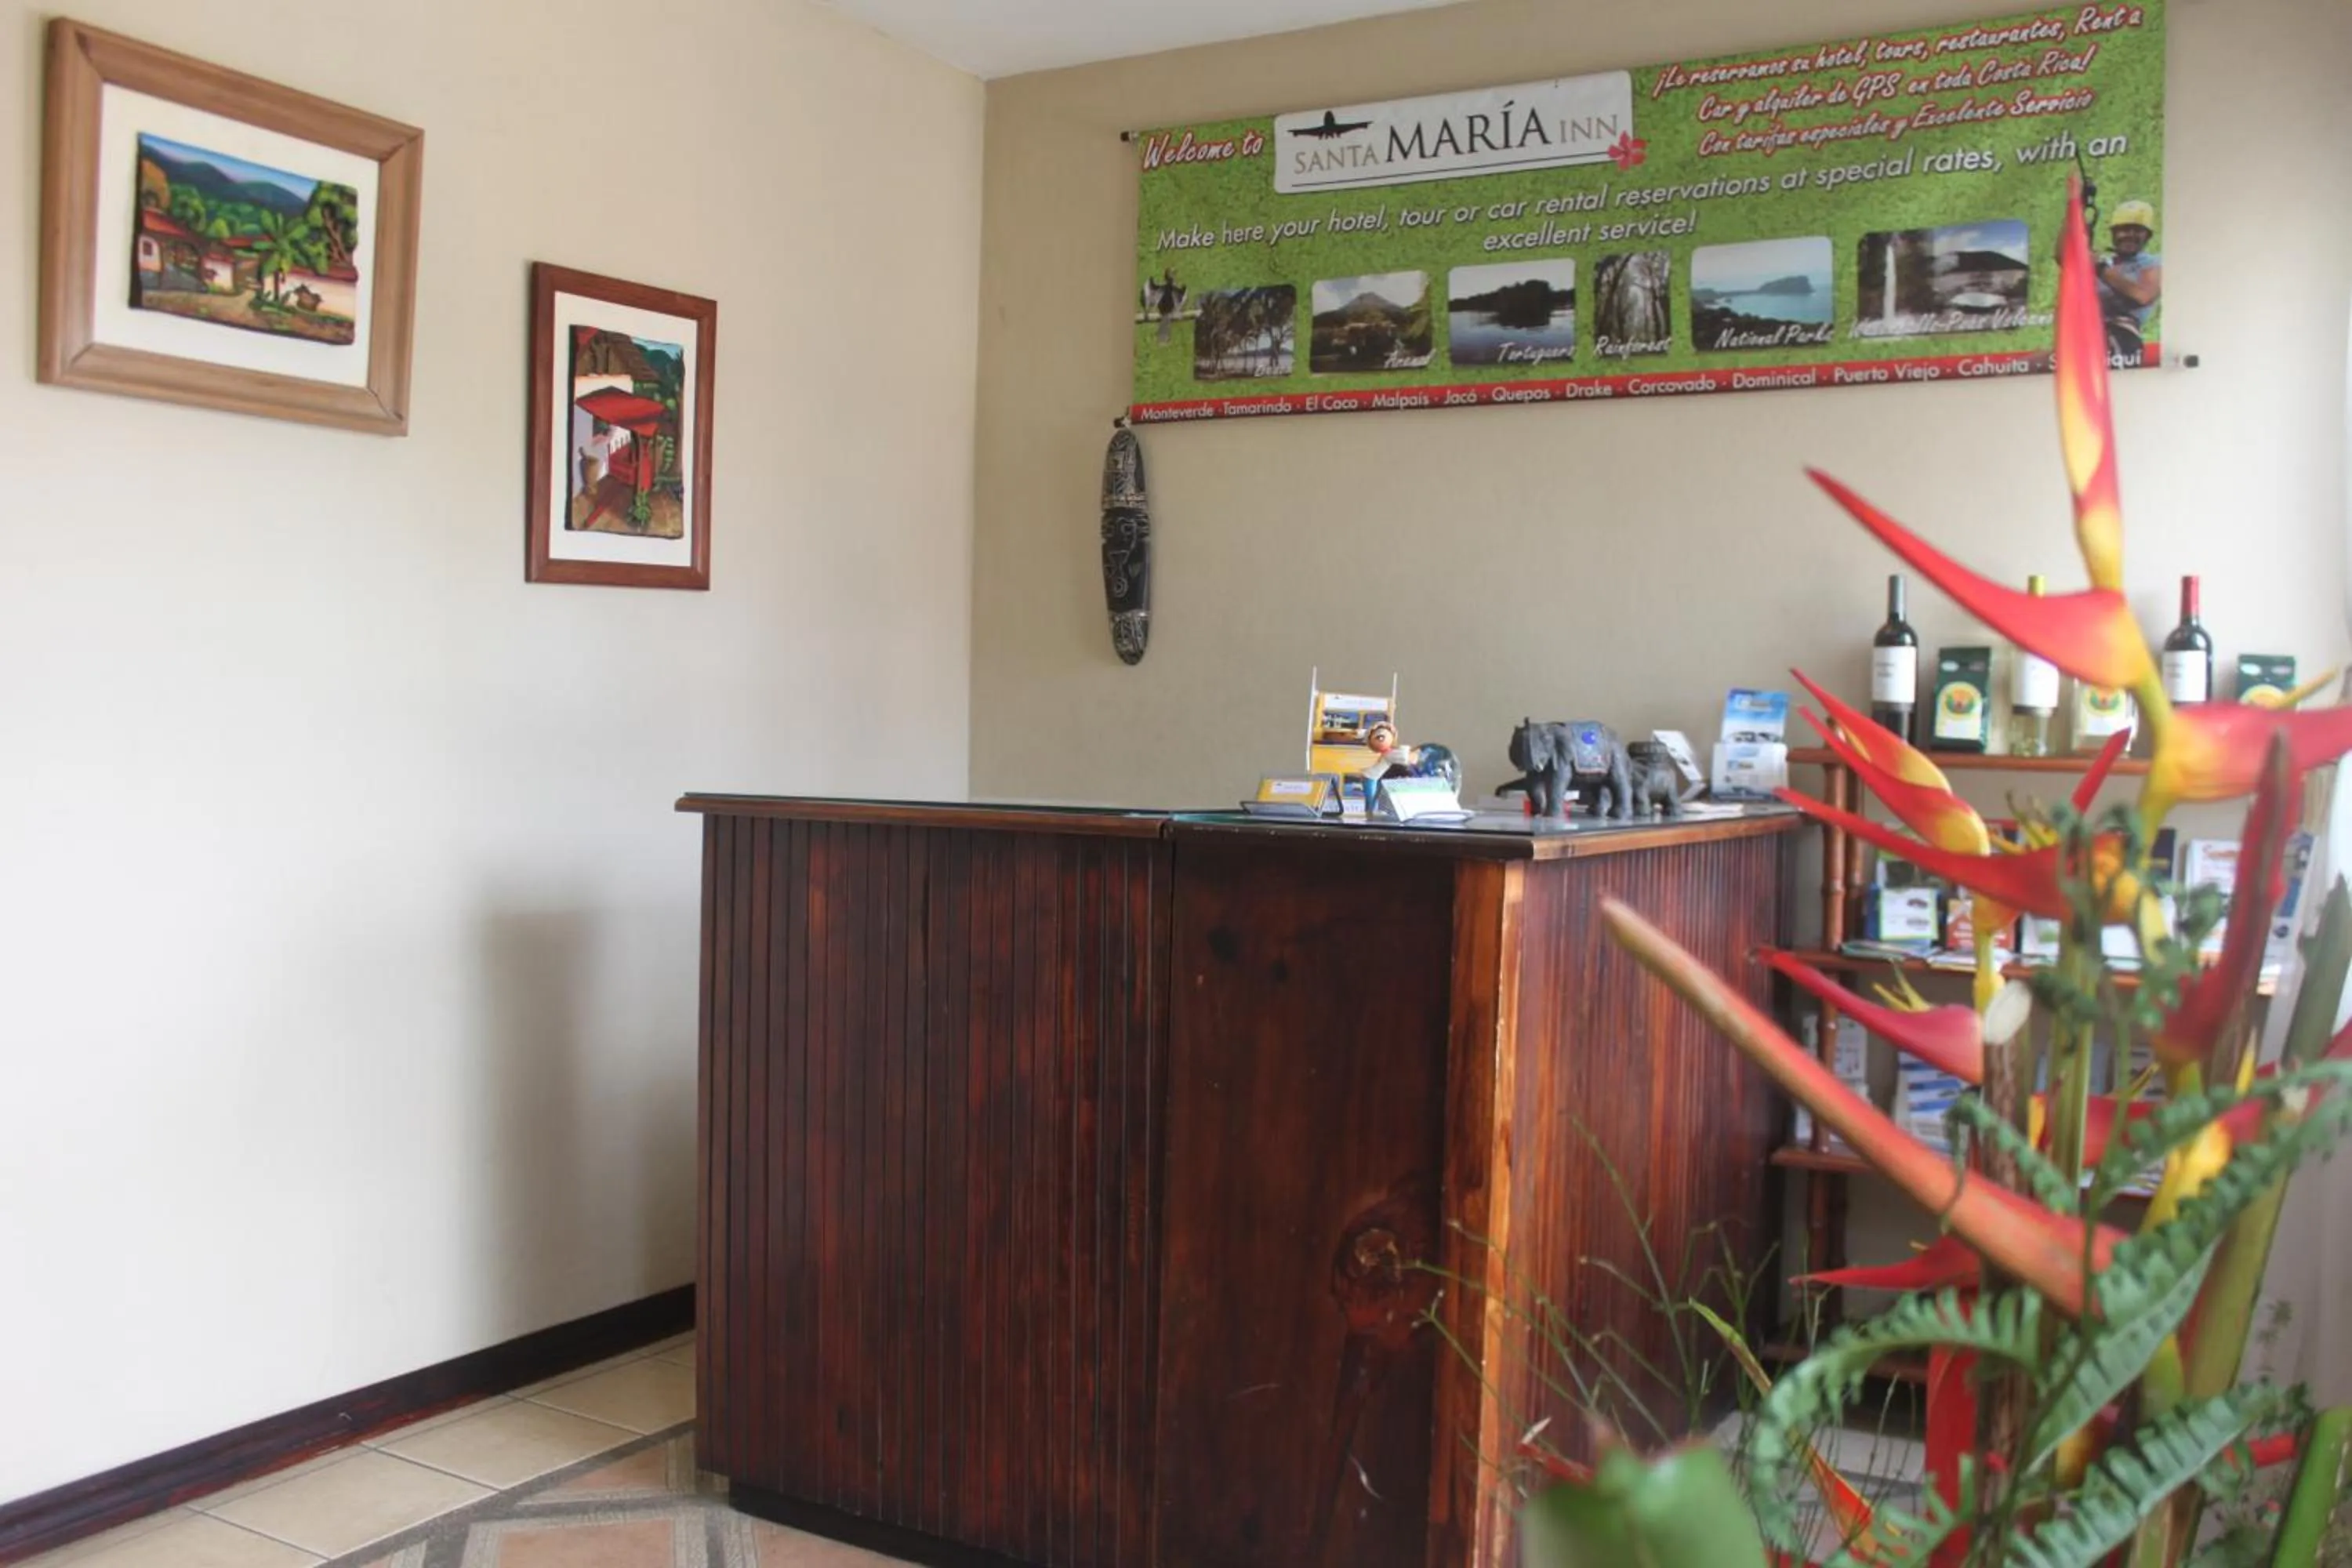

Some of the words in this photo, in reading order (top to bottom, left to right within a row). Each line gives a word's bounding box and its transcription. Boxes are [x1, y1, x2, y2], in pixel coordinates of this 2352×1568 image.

[1689, 60, 1788, 84] reservamos
[1791, 56, 1809, 71] su
[1816, 39, 1868, 68] hotel,
[1876, 41, 1929, 60] tours,
[1936, 20, 2065, 53] restaurantes,
[2074, 6, 2125, 34] Rent
[2128, 9, 2142, 25] a
[1699, 96, 1732, 121] Car
[1733, 103, 1749, 124] y
[1755, 84, 1824, 117] alquiler
[1828, 82, 1848, 103] de
[1853, 72, 1903, 107] GPS
[1907, 79, 1928, 93] en
[1934, 64, 1972, 89] toda
[1978, 60, 2032, 85] Costa
[2038, 43, 2097, 74] Rica!
[1142, 132, 1235, 170] Welcome
[1242, 131, 1264, 154] to
[1294, 144, 1379, 174] SANTA
[1385, 100, 1552, 163] MARÍA
[1559, 114, 1618, 143] INN
[1698, 131, 1730, 155] Con
[1736, 123, 1796, 154] tarifas
[1799, 113, 1888, 151] especiales
[1890, 118, 1907, 140] y
[1912, 98, 2006, 129] Excelente
[2009, 89, 2094, 115] Servicio
[1156, 223, 1214, 251] Make
[1221, 220, 1265, 244] here
[1269, 219, 1320, 246] your
[1327, 204, 1389, 233] hotel,
[1399, 207, 1446, 227] tour
[1454, 205, 1483, 223] or
[1487, 200, 1528, 221] car
[1535, 183, 1610, 216] rental
[1615, 172, 1771, 207] reservations
[1780, 167, 1808, 191] at
[1817, 145, 1915, 191] special
[1922, 147, 2003, 174] rates,
[2016, 129, 2077, 164] with
[2088, 134, 2128, 158] an
[1483, 221, 1592, 252] excellent
[1599, 207, 1698, 241] service!
[1594, 336, 1673, 360] Rainforest
[1714, 324, 1785, 349] National
[1784, 321, 1835, 345] Parks
[1141, 403, 1214, 421] Monteverde
[1223, 397, 1292, 416] Tamarindo
[1305, 396, 1319, 412] El
[1323, 396, 1359, 410] Coco
[1443, 388, 1478, 405] Jacó
[1492, 386, 1552, 403] Quepos
[1566, 379, 1613, 398] Drake
[1628, 374, 1717, 395] Corcovado
[1733, 367, 1817, 389] Dominical
[1834, 366, 1888, 383] Puerto
[1894, 363, 1940, 383] Viejo
[1958, 357, 2029, 375] Cahuita
[2048, 348, 2142, 371] Siquí
